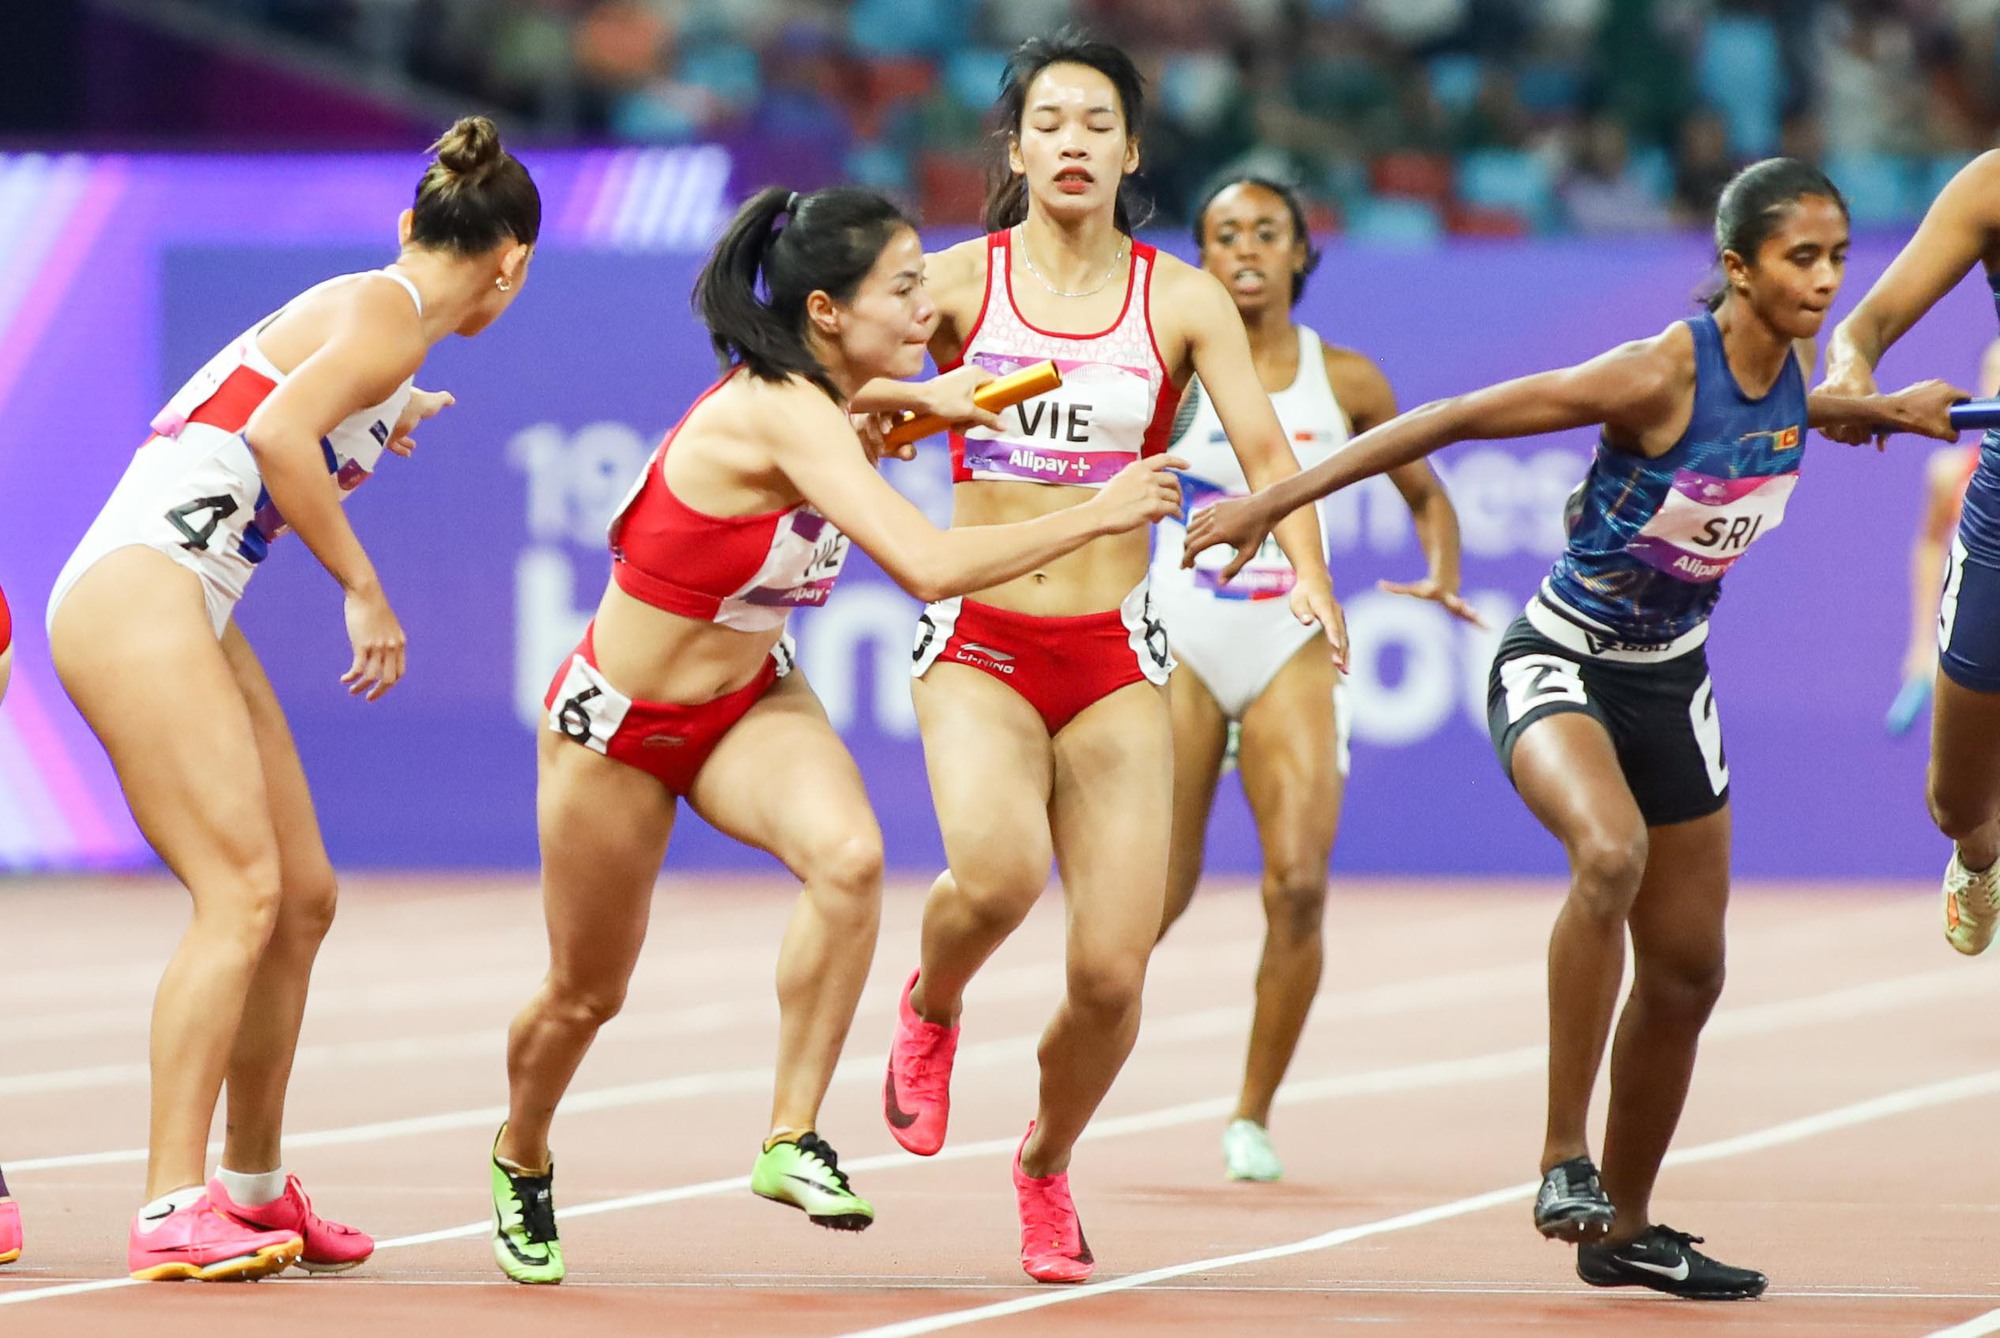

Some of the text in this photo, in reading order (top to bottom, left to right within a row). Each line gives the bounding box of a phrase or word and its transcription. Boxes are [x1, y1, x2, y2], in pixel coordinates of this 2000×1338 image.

[1017, 400, 1093, 443] VIE
[164, 494, 239, 551] 4
[1691, 514, 1764, 551] SRI
[956, 651, 1015, 674] LI-NING
[1518, 663, 1569, 703] 2
[559, 685, 603, 745] 6
